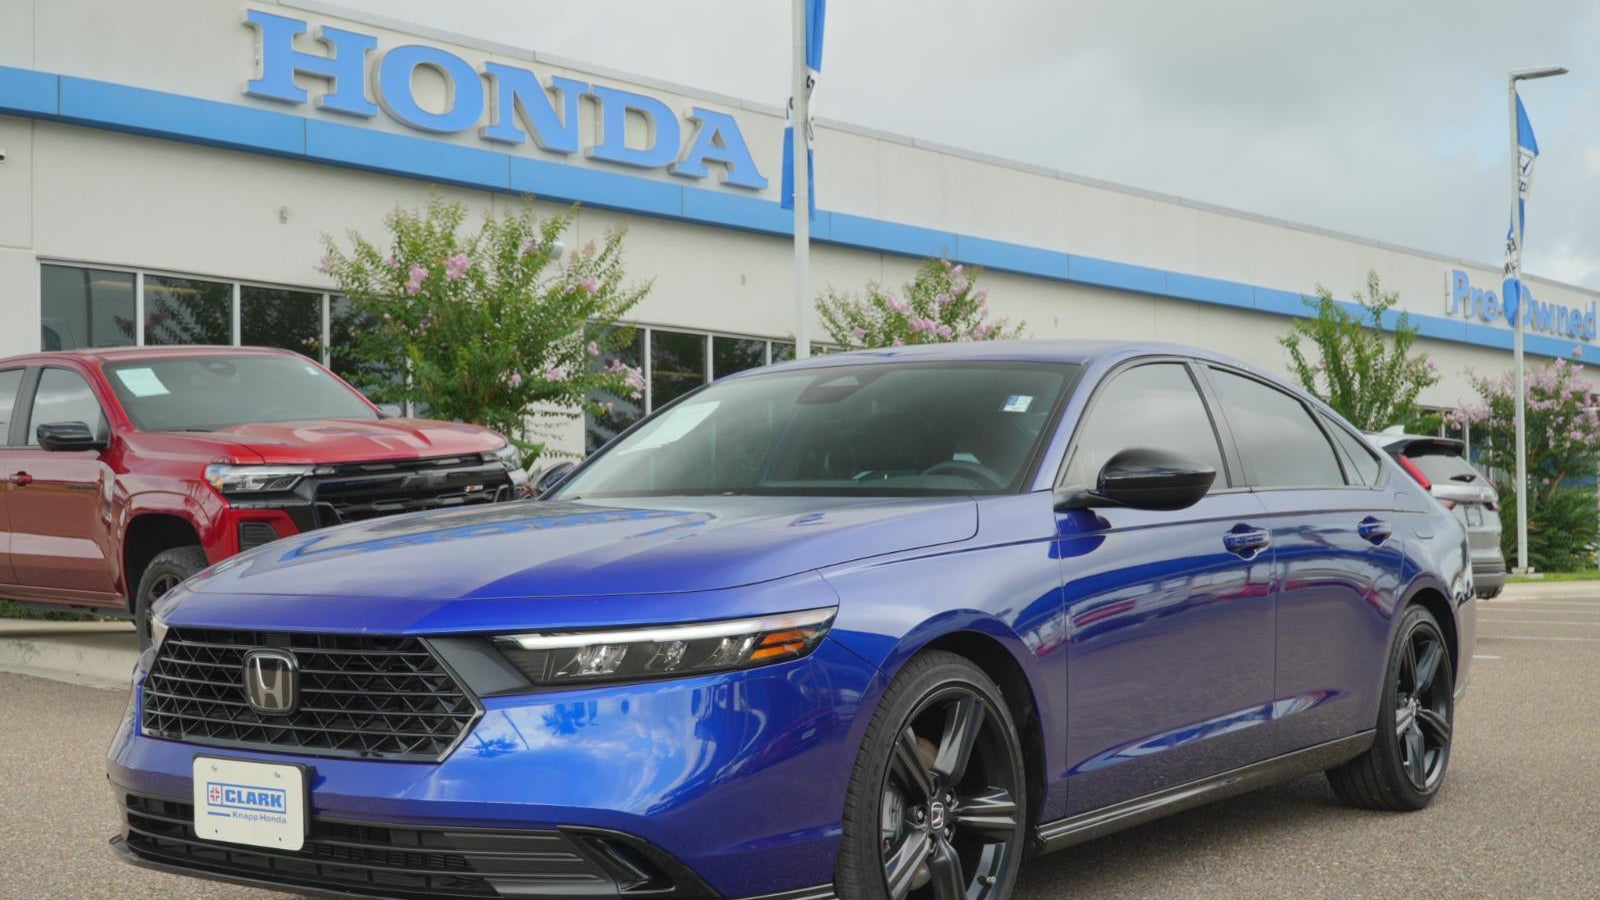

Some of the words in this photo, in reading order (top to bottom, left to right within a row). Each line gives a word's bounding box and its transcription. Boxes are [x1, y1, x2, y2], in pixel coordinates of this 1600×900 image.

[246, 9, 769, 190] HONDA
[224, 789, 283, 808] CLARK
[232, 811, 259, 823] Knapp
[260, 814, 287, 824] Honda
